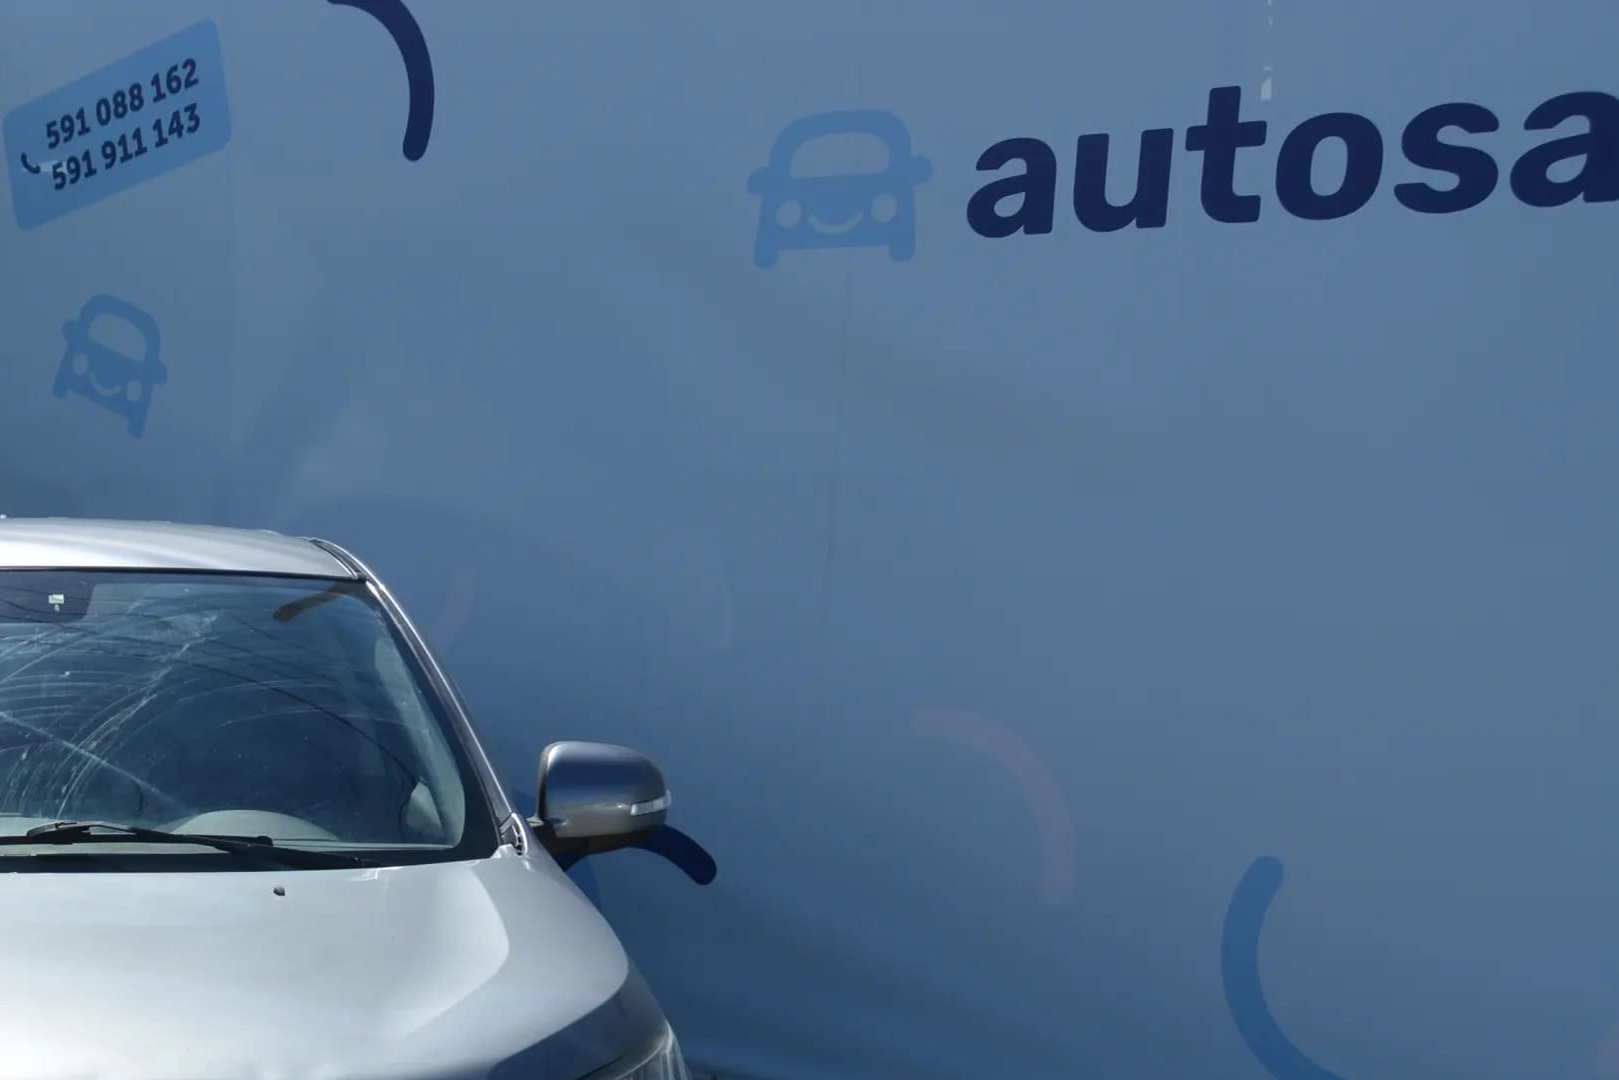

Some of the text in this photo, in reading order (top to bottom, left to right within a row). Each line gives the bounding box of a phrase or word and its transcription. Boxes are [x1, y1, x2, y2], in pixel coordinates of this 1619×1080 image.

[45, 57, 200, 151] 591 088 162
[51, 101, 201, 192] 591 911 143
